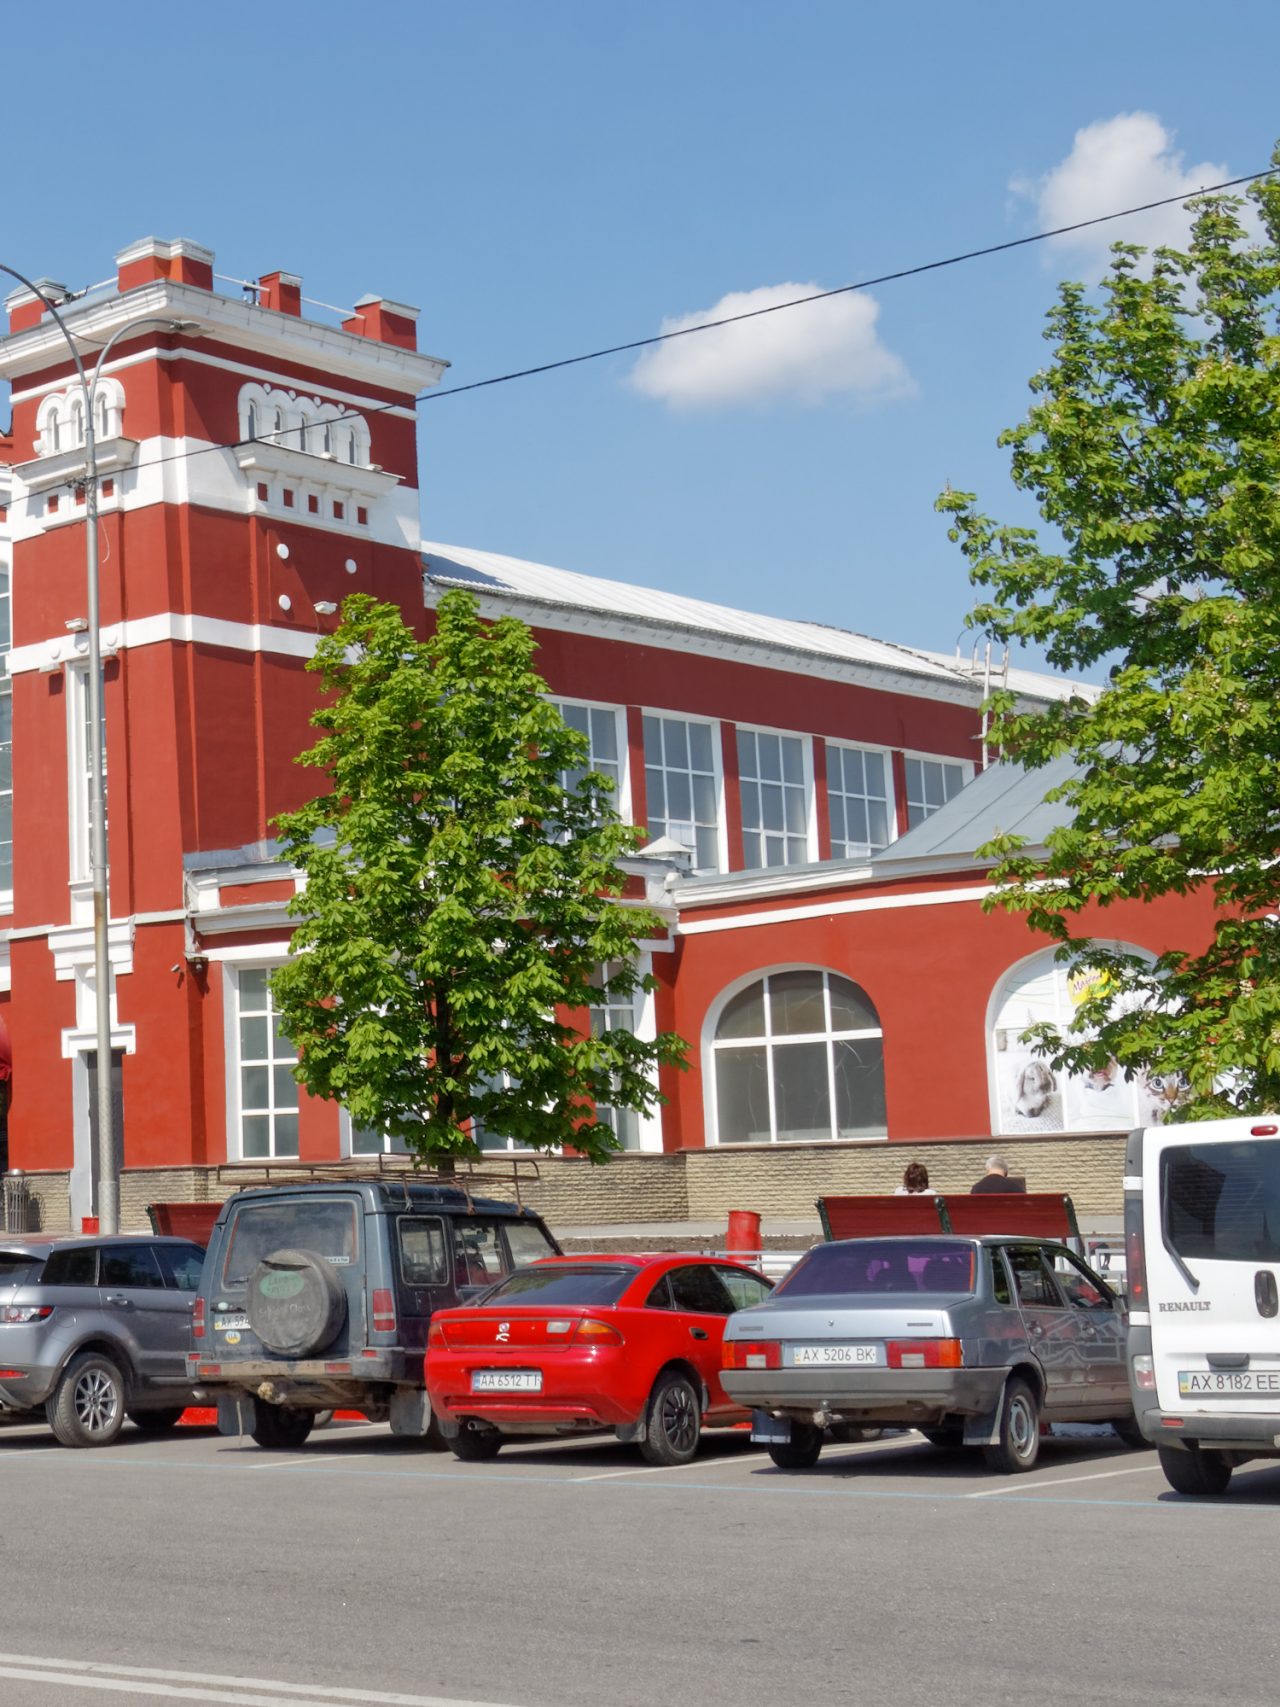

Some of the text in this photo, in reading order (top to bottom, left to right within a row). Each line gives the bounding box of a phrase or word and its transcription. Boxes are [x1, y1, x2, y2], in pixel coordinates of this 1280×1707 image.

[1158, 1301, 1211, 1312] RENAULT
[803, 1348, 873, 1361] AX 5206 BK
[480, 1374, 495, 1387] AA
[497, 1374, 522, 1387] 6512
[1191, 1374, 1280, 1390] AX 8182 EE
